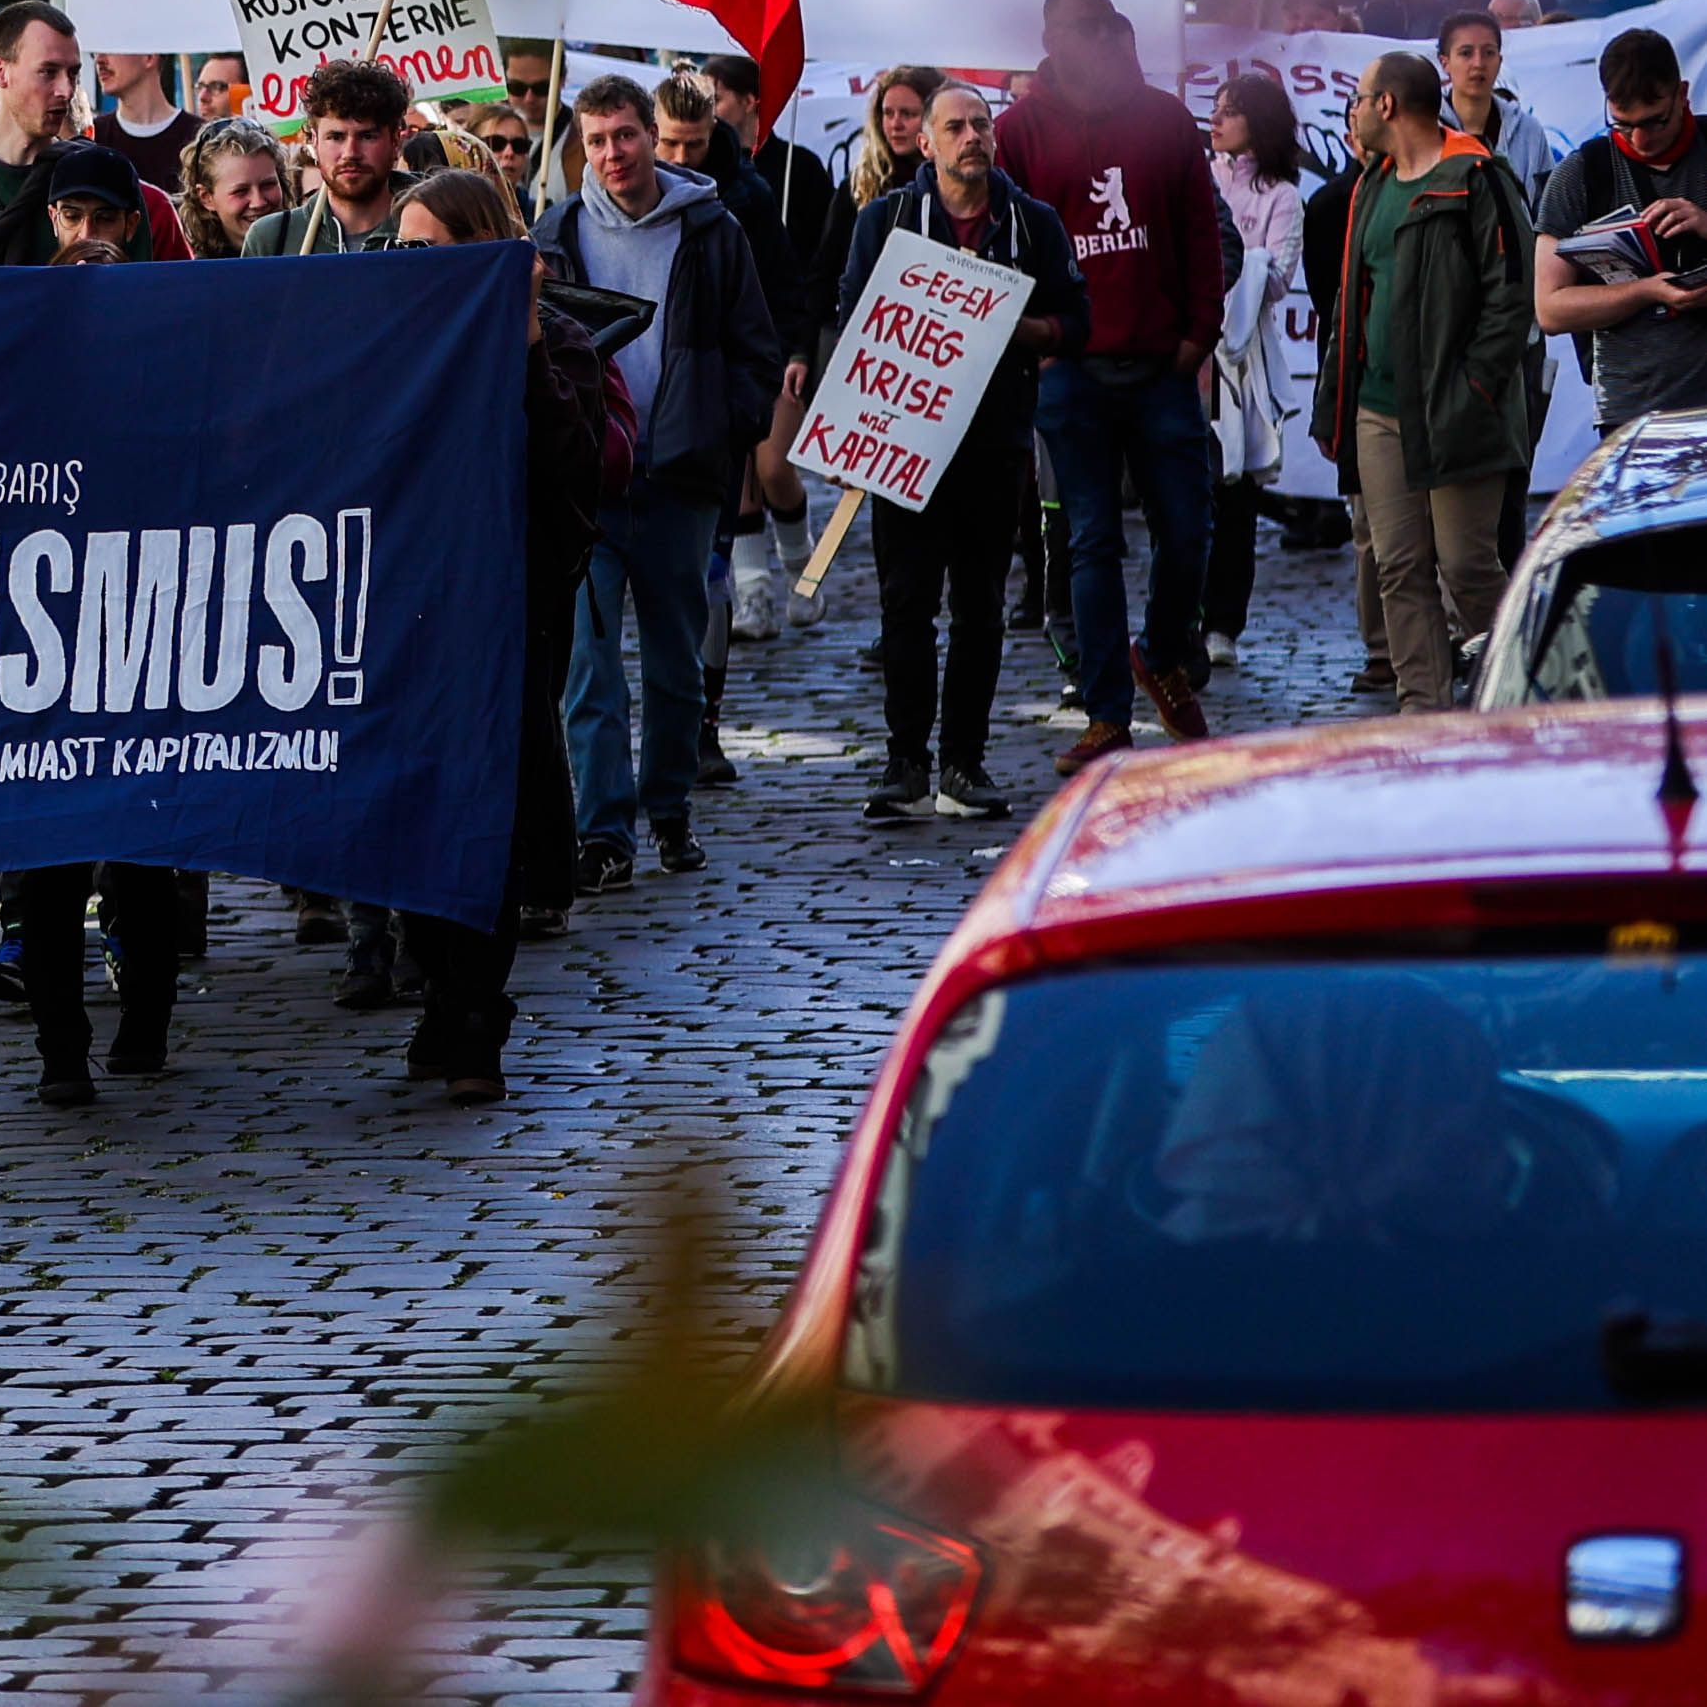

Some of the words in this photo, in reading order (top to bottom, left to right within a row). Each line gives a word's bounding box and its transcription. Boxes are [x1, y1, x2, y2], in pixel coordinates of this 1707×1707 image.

[1073, 224, 1149, 262] BERLIN
[899, 263, 1010, 321] GEGEN
[861, 295, 965, 369] KRIEG
[845, 348, 954, 422] KRISE
[857, 410, 891, 434] und
[797, 414, 931, 503] KAPITAL
[112, 728, 340, 777] KAPITALIZMU!
